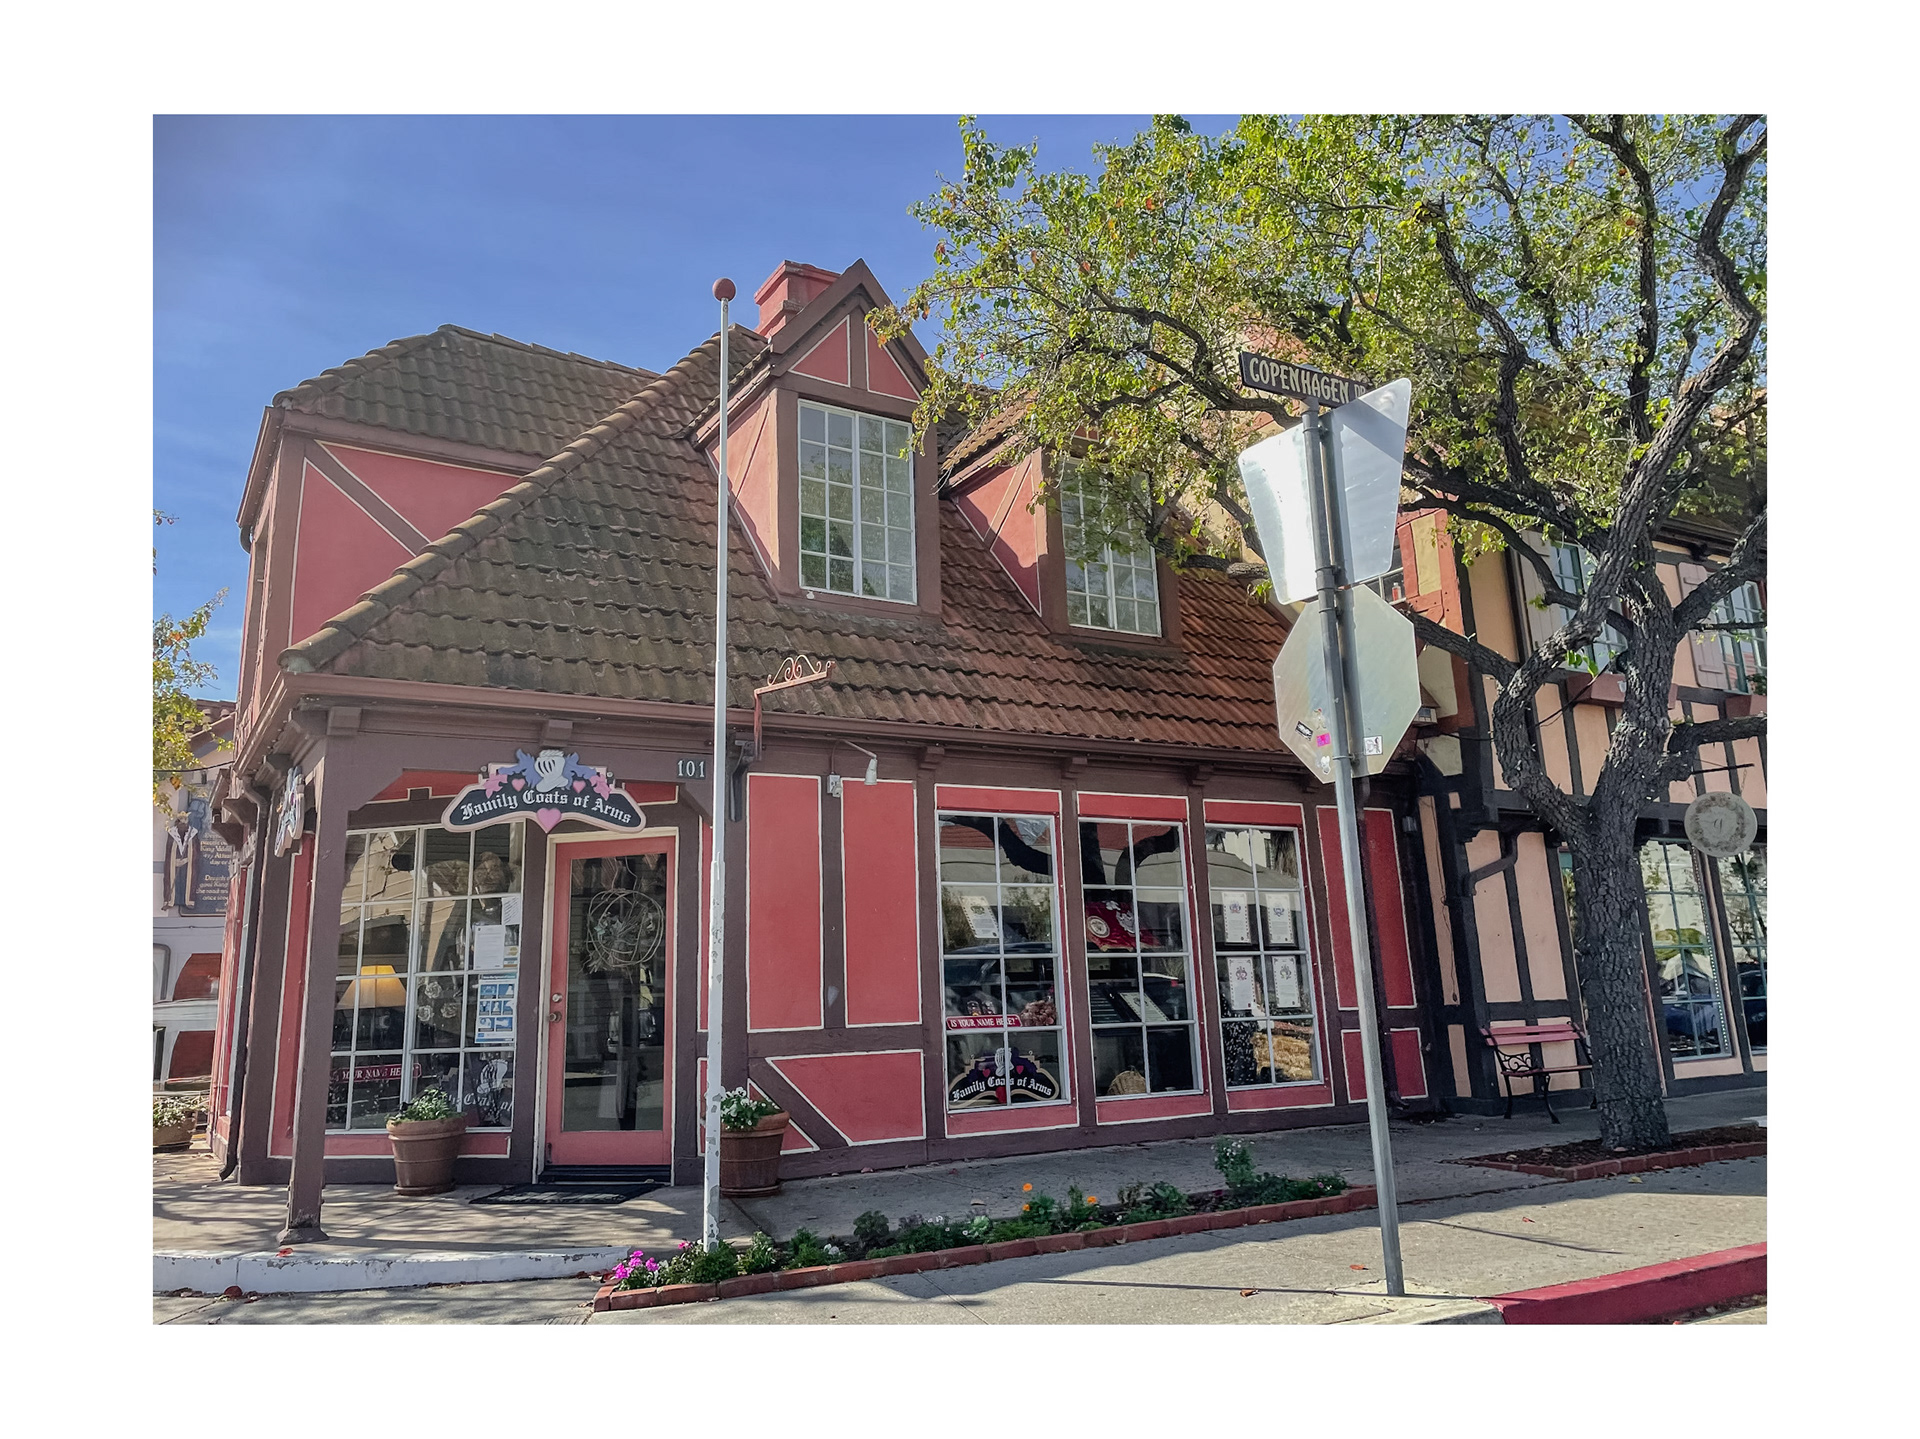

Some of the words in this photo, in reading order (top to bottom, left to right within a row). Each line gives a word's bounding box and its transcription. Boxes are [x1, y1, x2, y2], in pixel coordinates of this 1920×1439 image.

[1249, 357, 1350, 404] COPENHAGEN
[677, 759, 705, 778] 101
[460, 793, 518, 821] Family
[523, 789, 568, 805] Coats
[573, 795, 590, 808] of
[591, 798, 631, 824] Arms
[958, 1019, 975, 1027] YOUR
[977, 1018, 994, 1026] NAME
[952, 1081, 986, 1102] Family
[987, 1076, 1014, 1087] Coas
[1017, 1077, 1027, 1087] of
[1028, 1078, 1052, 1096] Arms
